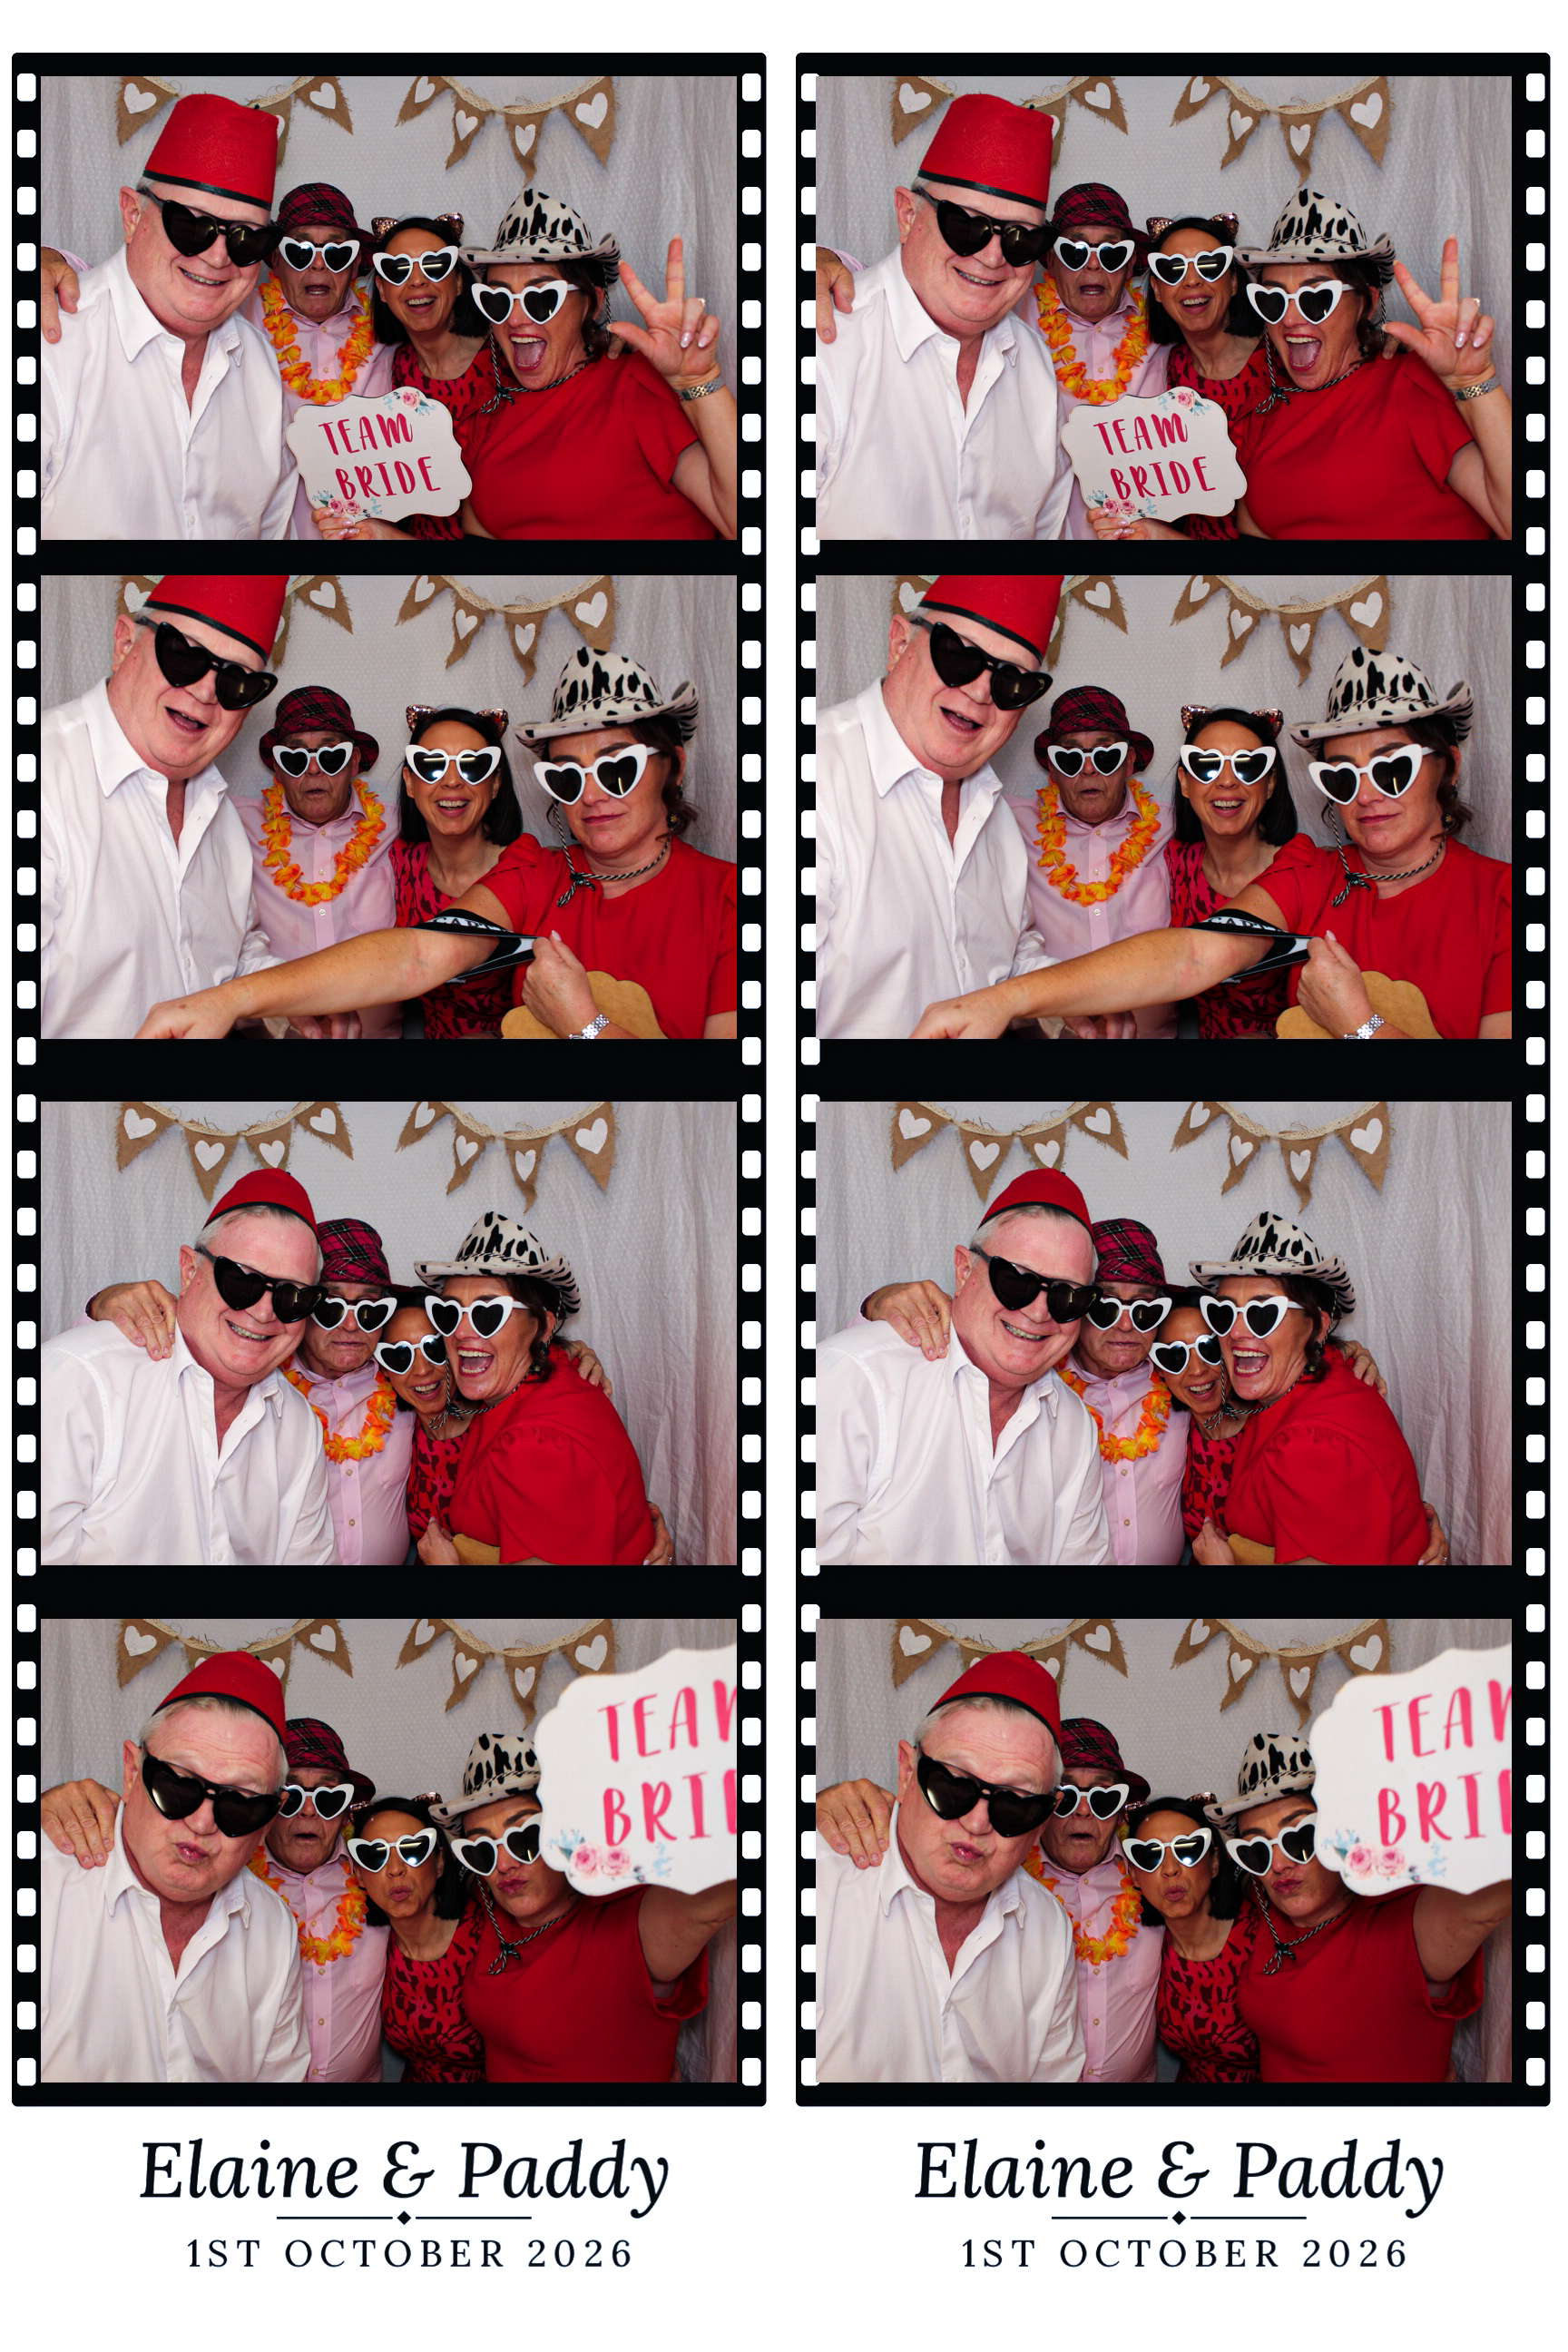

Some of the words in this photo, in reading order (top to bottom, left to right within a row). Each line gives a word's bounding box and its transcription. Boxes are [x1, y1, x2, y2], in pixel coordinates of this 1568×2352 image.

[318, 413, 414, 456] TEAM
[1093, 413, 1189, 456] TEAM
[335, 456, 441, 500] BRIDE
[1110, 456, 1216, 500] BRIDE
